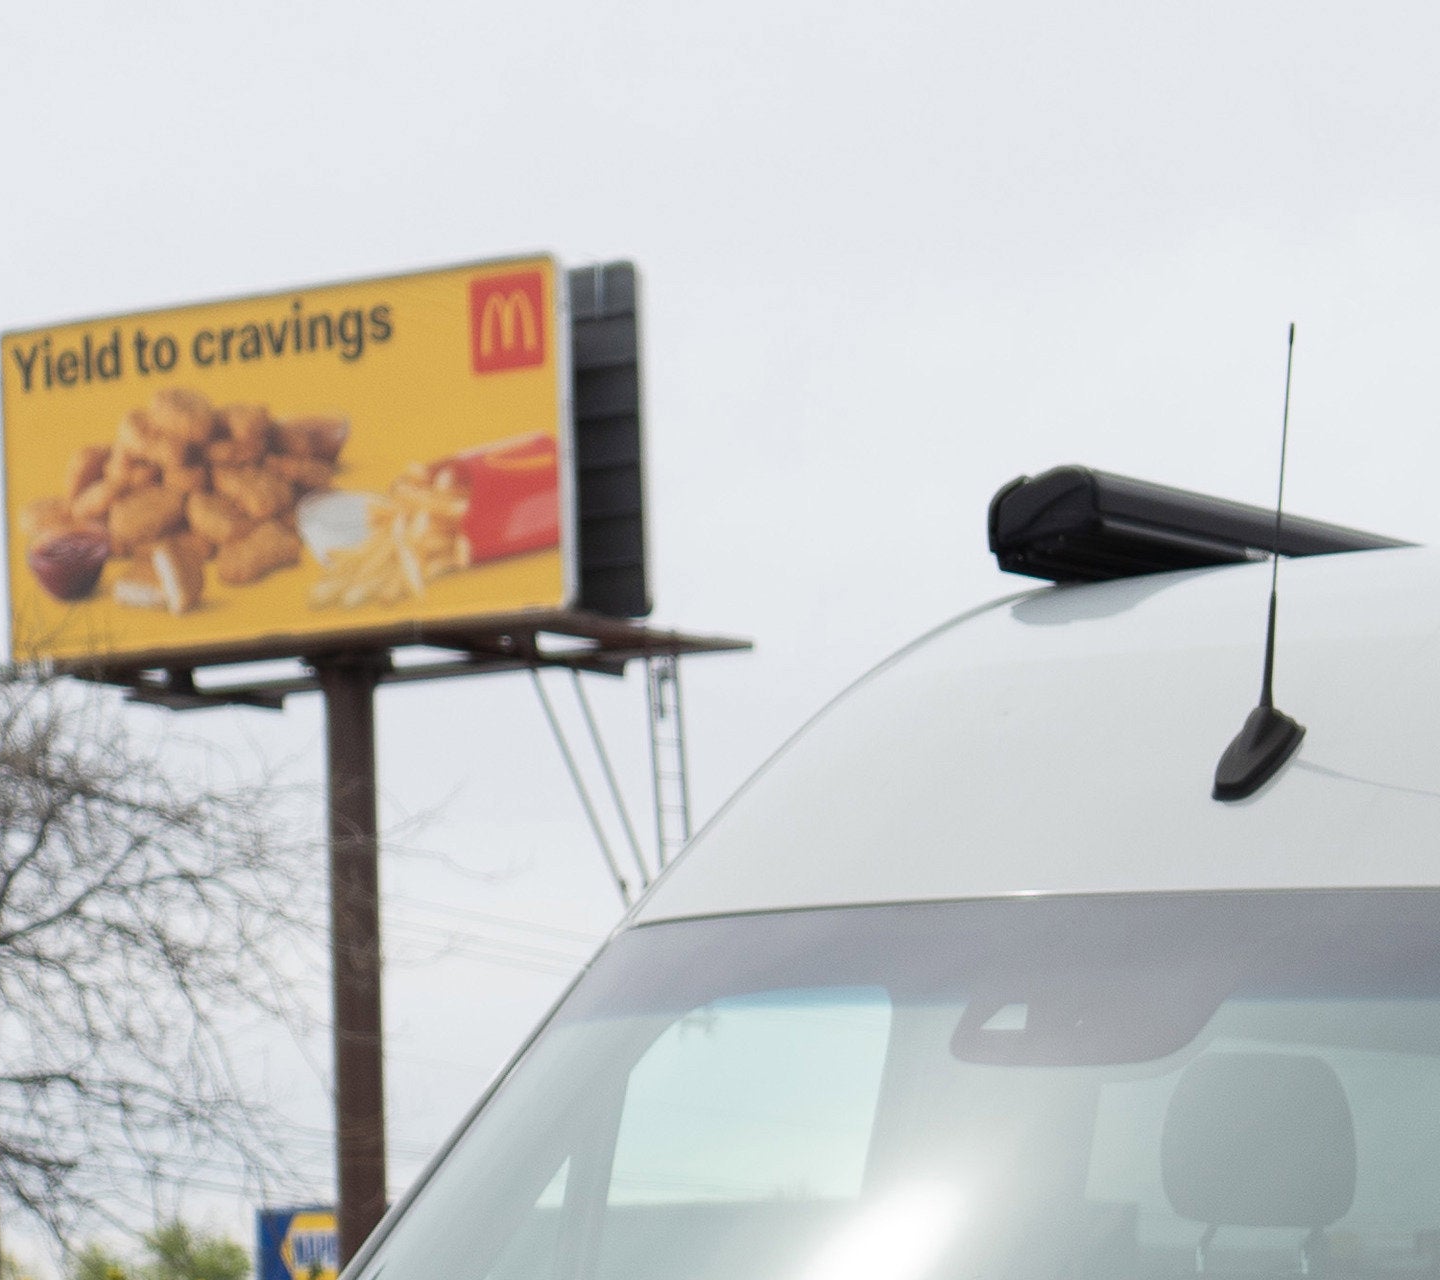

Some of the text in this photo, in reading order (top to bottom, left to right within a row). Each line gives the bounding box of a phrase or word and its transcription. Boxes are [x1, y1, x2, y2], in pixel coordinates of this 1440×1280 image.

[13, 299, 393, 392] Yield to cravings
